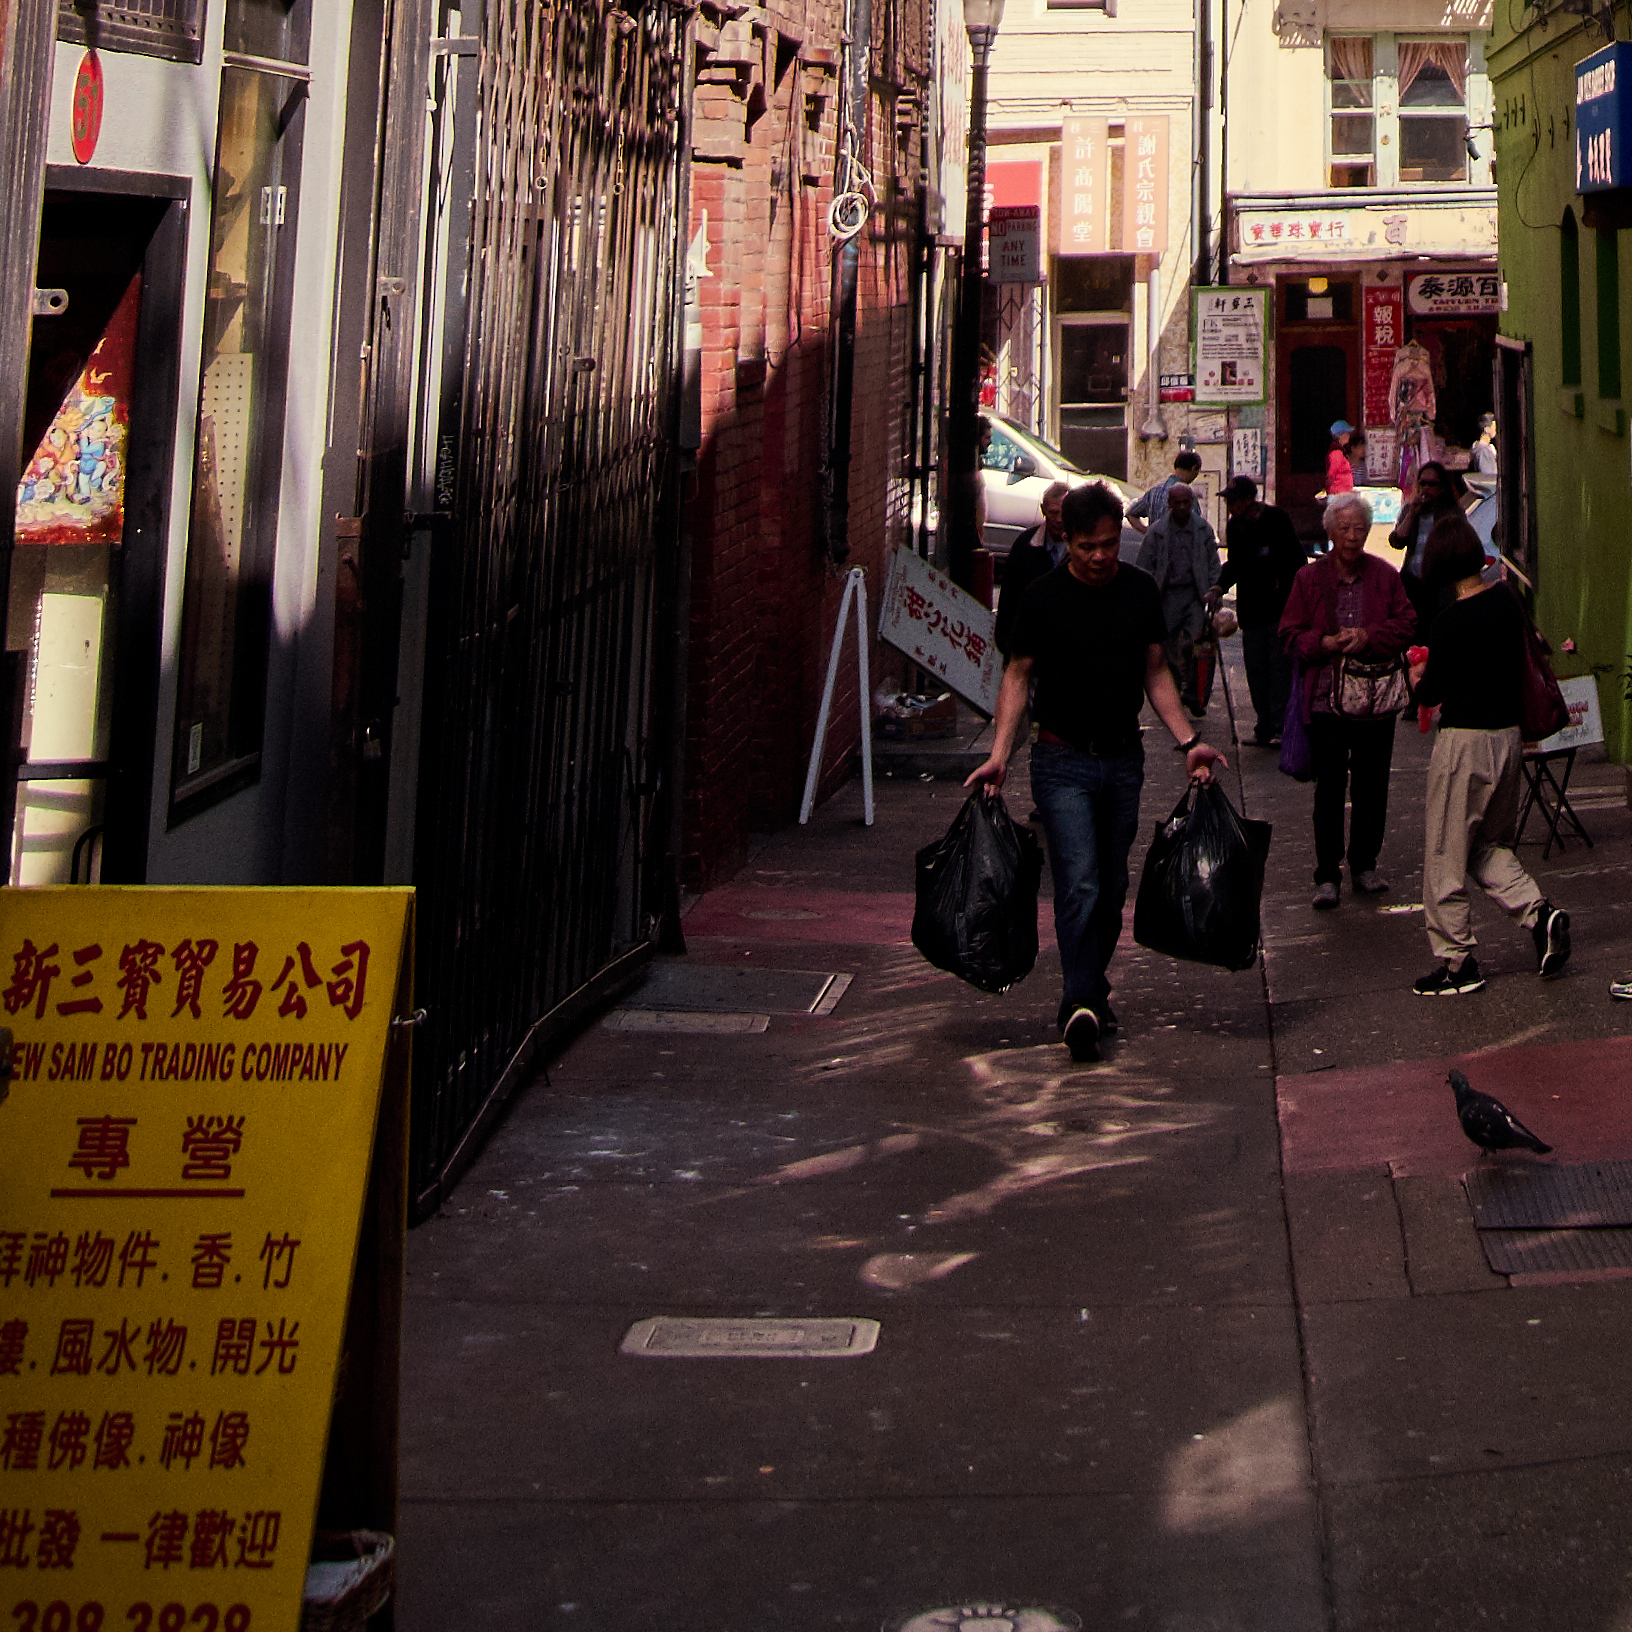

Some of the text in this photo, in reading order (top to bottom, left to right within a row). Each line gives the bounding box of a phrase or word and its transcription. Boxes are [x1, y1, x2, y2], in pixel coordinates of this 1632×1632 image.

[1001, 254, 1027, 267] TIME
[1002, 239, 1025, 252] ANY
[3, 938, 371, 1021] 新三寶貿易公司
[11, 1042, 349, 1081] EW SAM BO TRADING COMPANY
[68, 1114, 246, 1181] 專營
